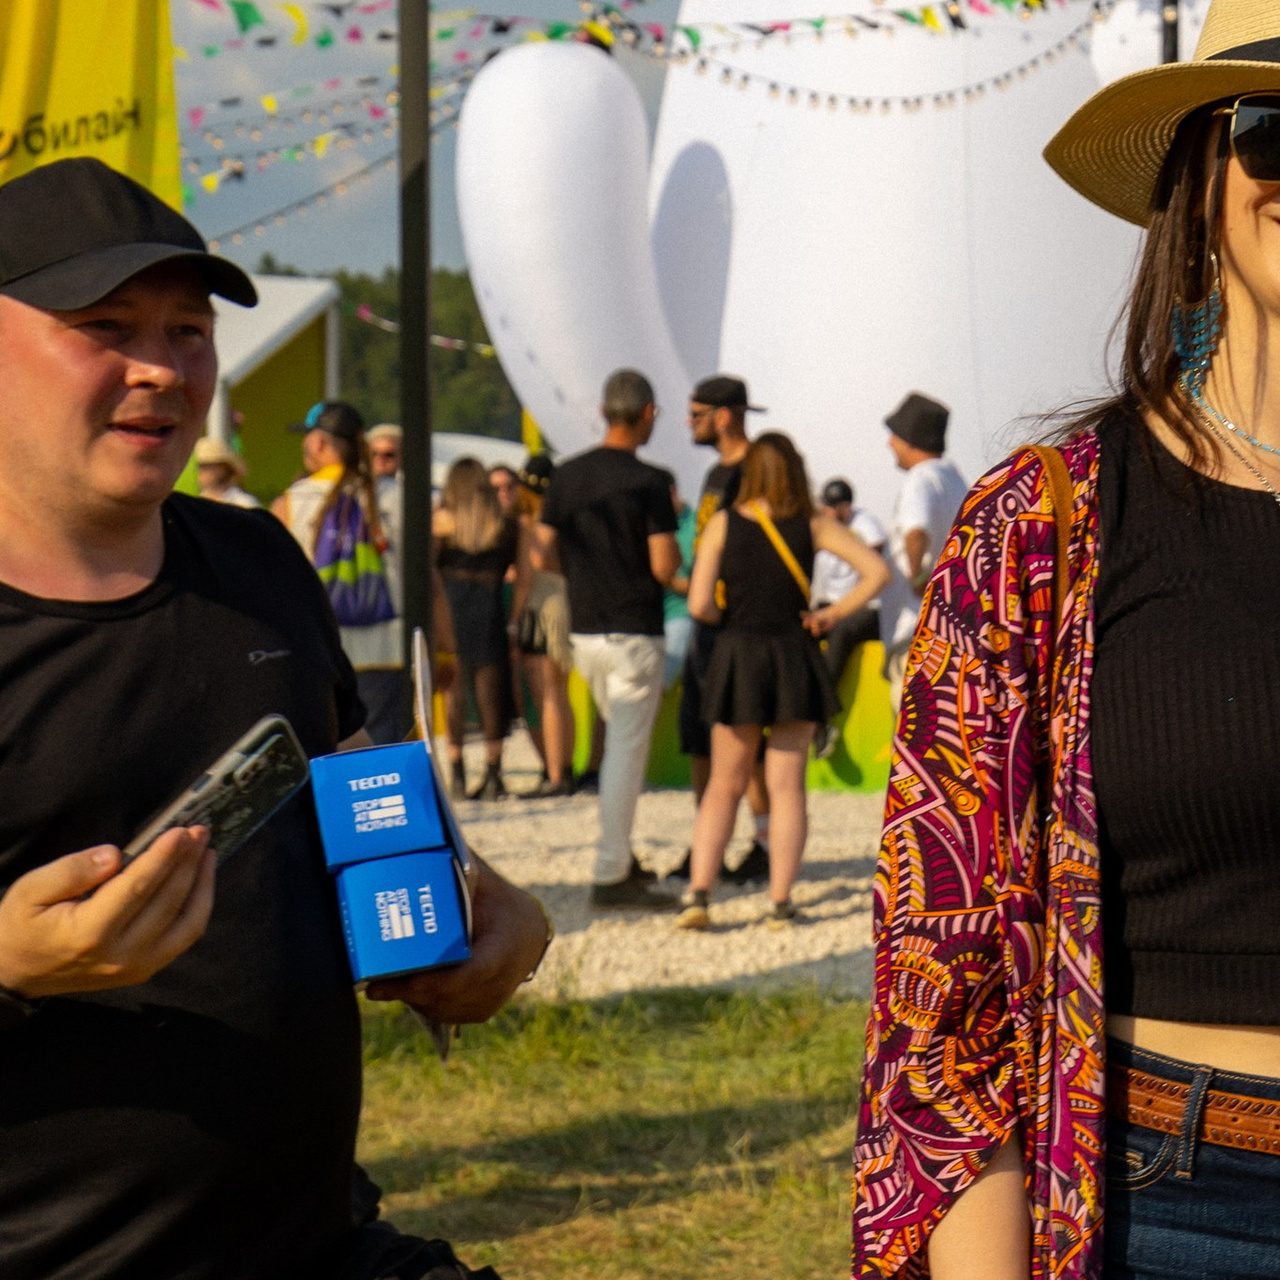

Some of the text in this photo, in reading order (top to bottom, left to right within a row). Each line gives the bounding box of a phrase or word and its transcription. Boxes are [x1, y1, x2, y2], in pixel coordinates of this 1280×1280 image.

[347, 772, 401, 791] TECNO
[351, 798, 382, 813] STOP
[354, 810, 370, 823] AT
[355, 815, 408, 833] NOTHING
[386, 890, 399, 903] AT
[397, 888, 411, 915] STOP
[374, 891, 391, 941] NOTHING
[417, 883, 438, 934] TECNO
